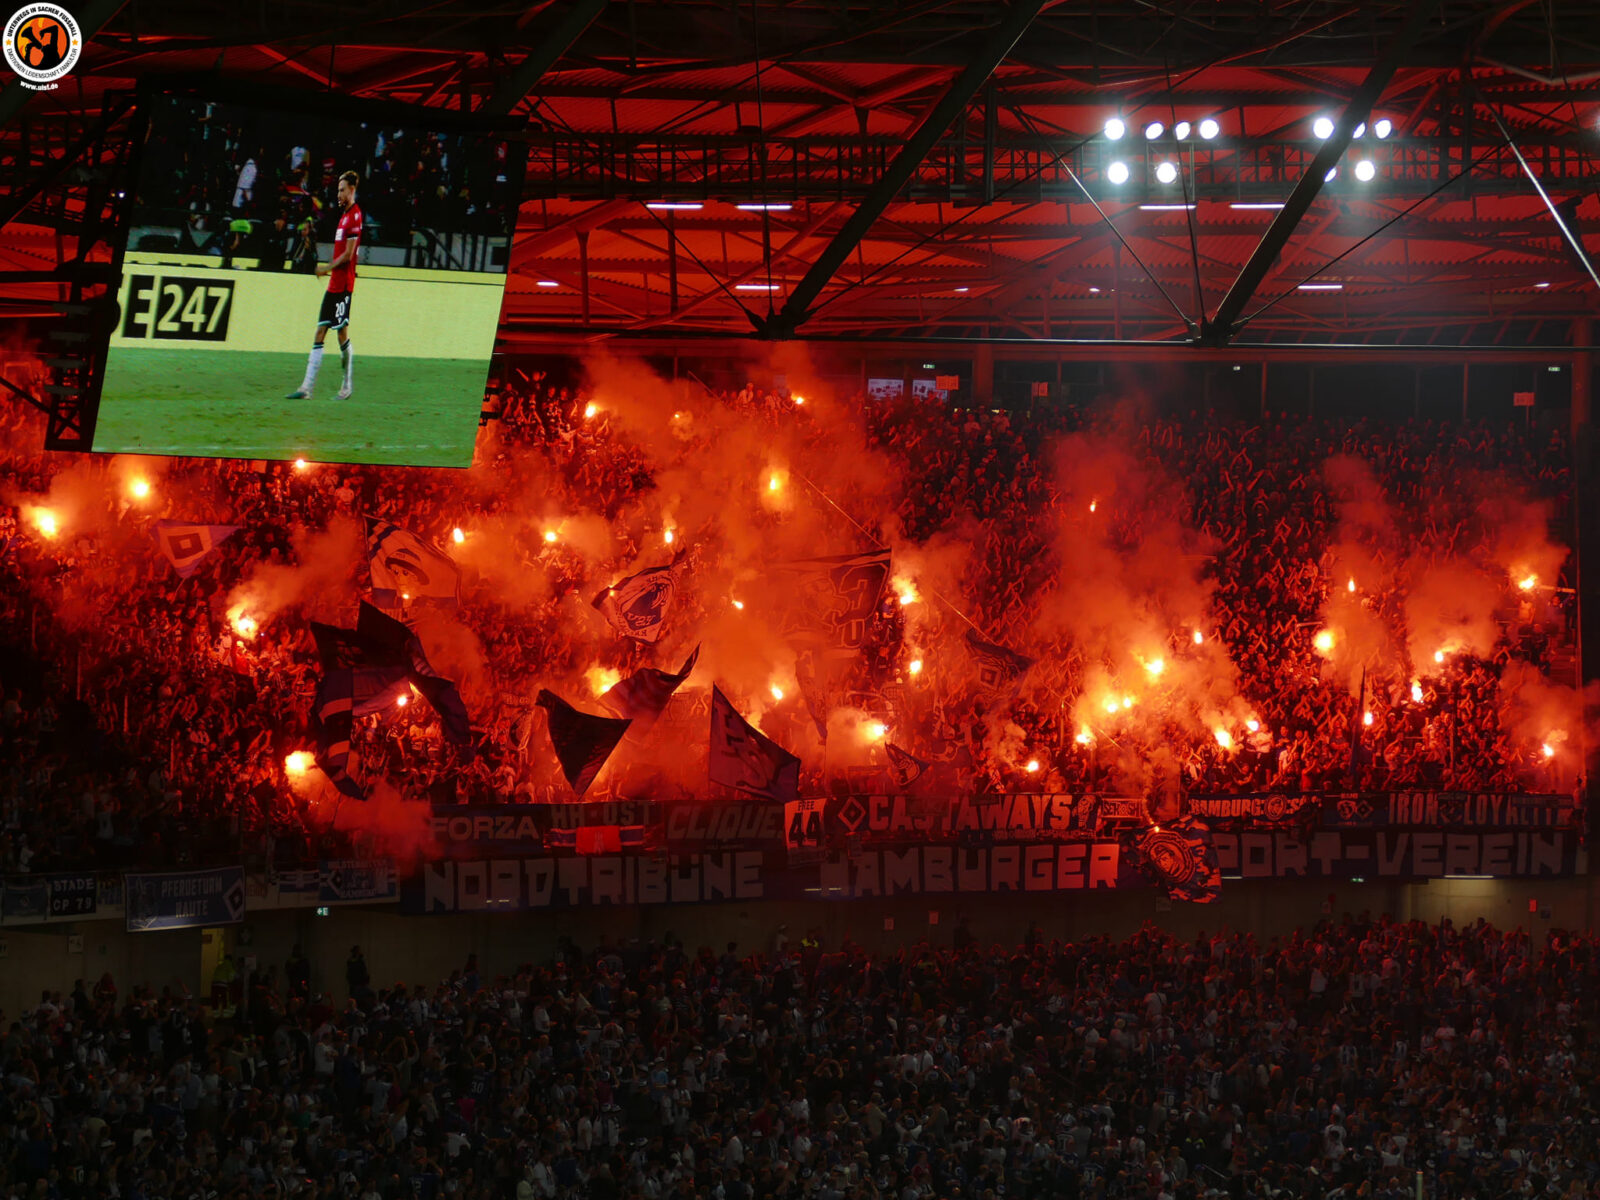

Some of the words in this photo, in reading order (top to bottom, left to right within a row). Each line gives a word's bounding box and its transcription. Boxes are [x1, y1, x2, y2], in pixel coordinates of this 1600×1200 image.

[1388, 793, 1438, 825] IRON
[429, 815, 540, 841] FORZA
[820, 843, 1120, 897] HAMBURGER
[1212, 832, 1563, 877] PORT-VEREIN
[53, 878, 96, 892] STADE
